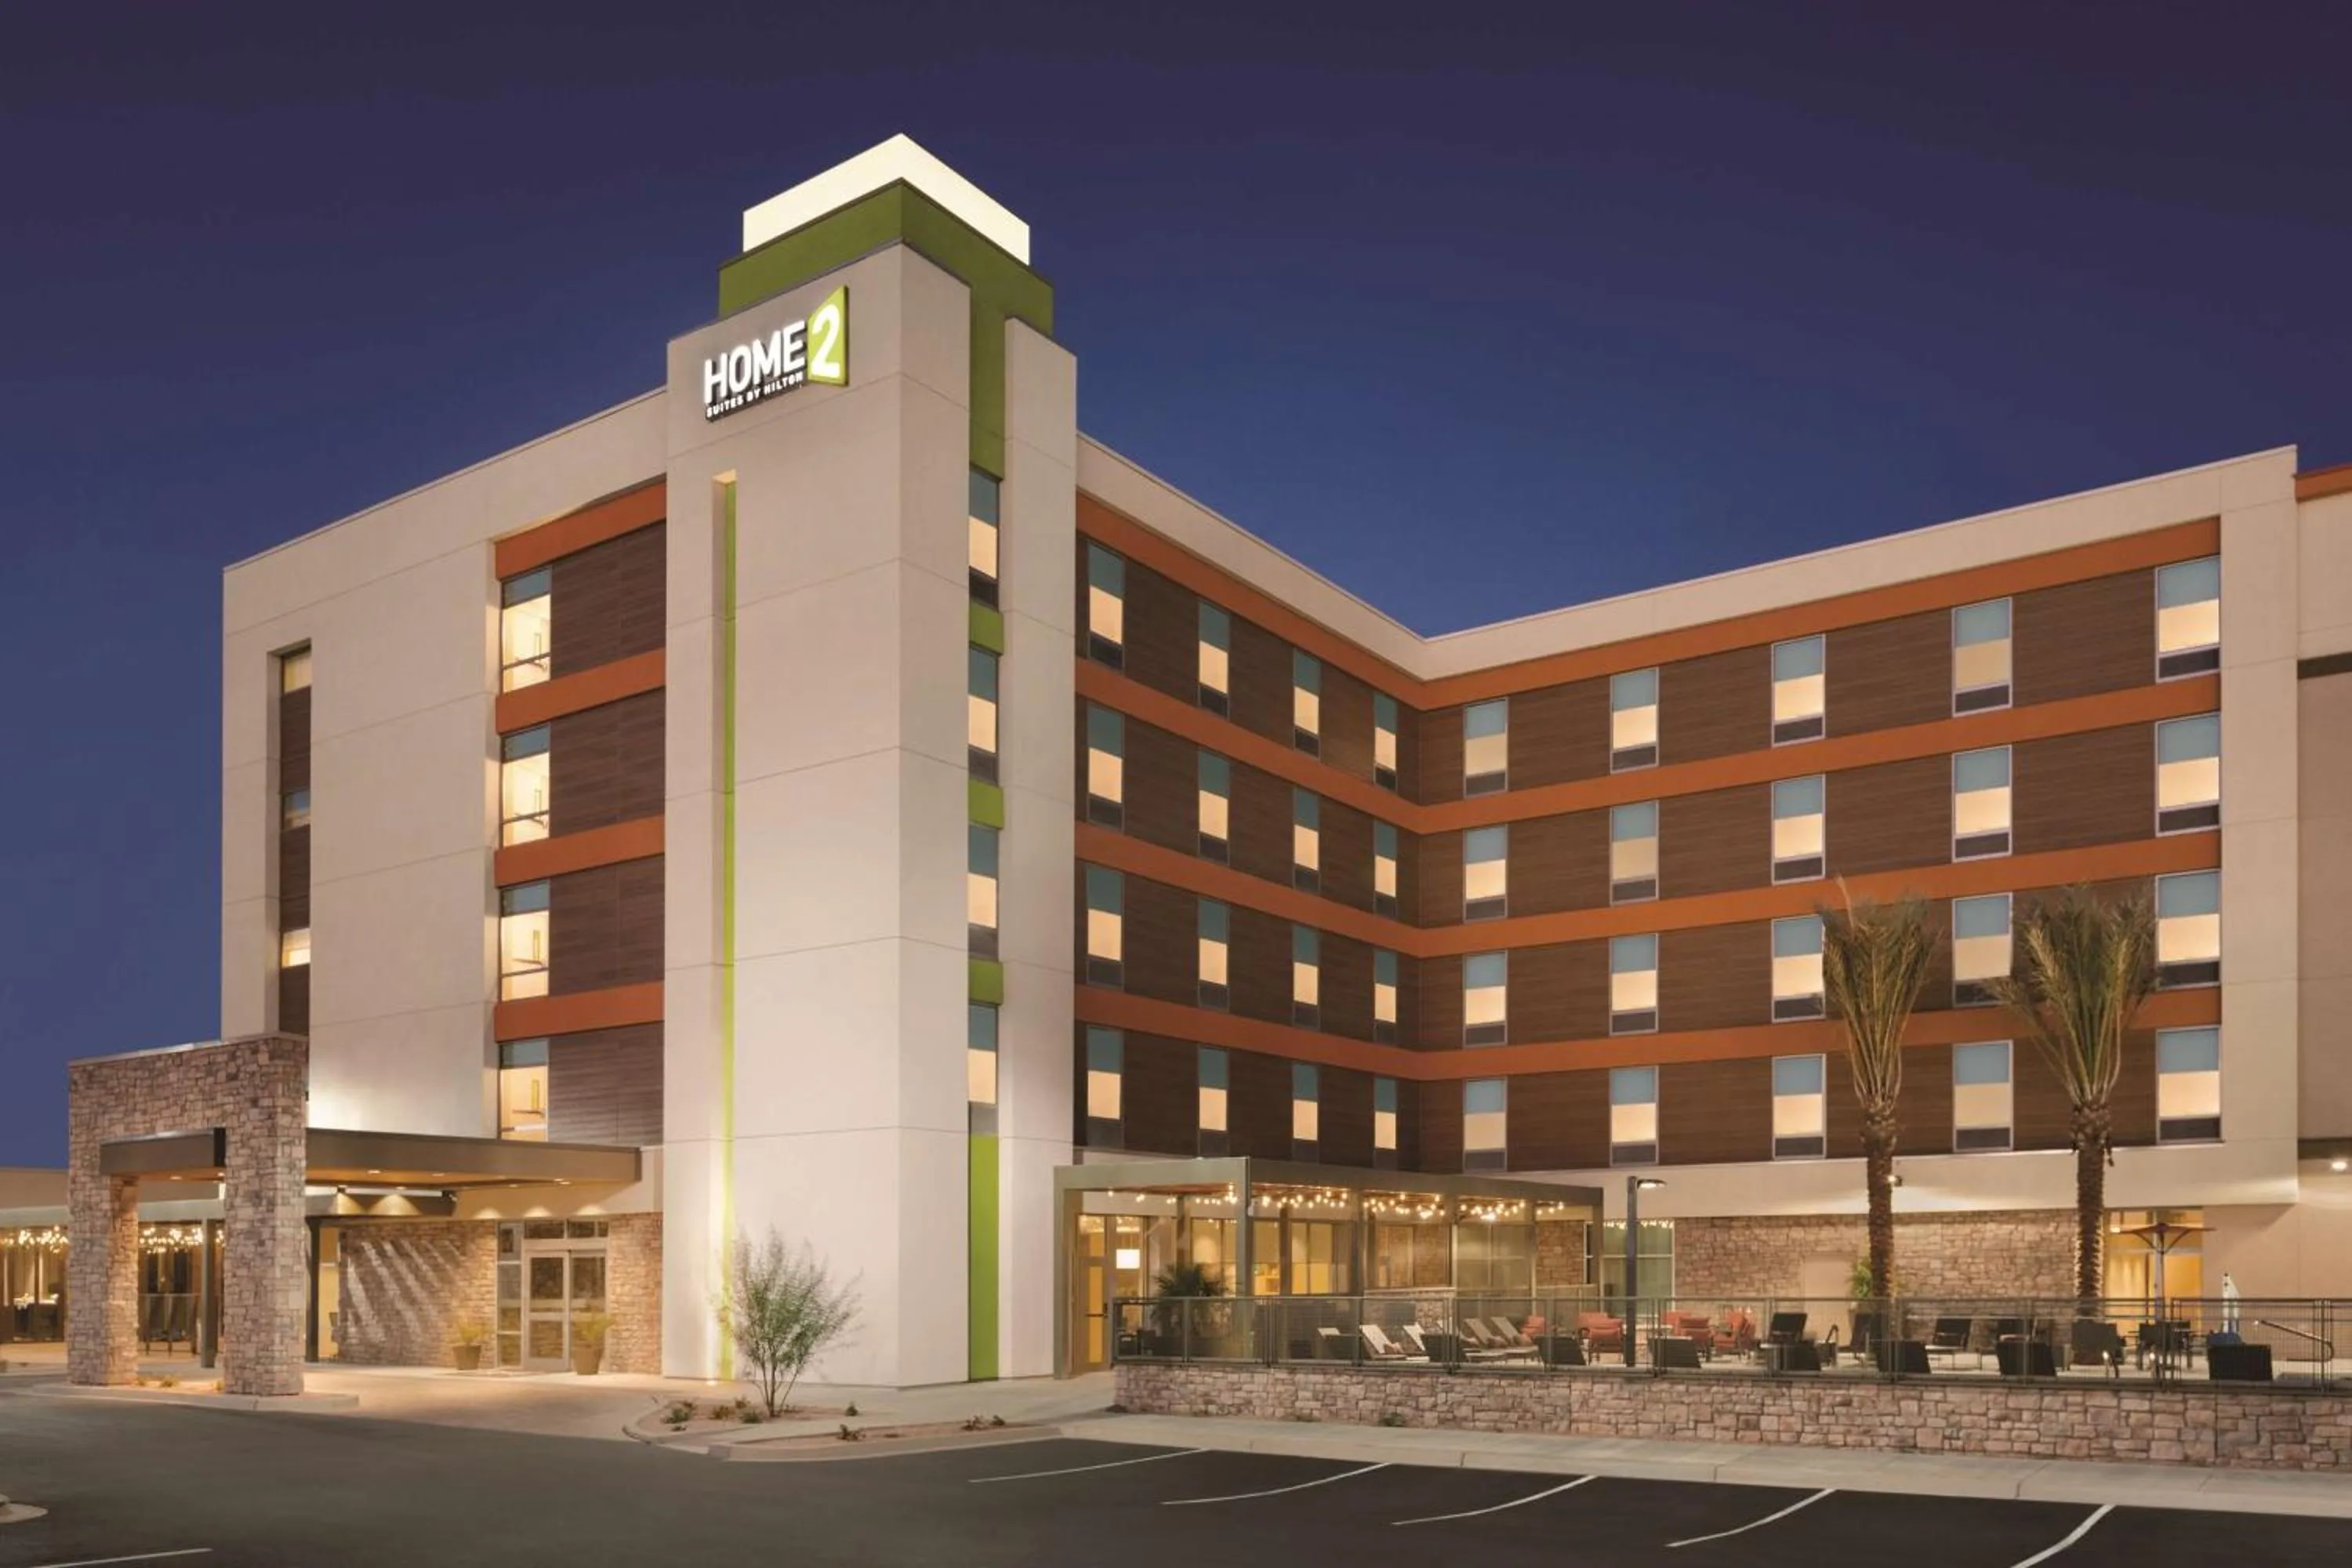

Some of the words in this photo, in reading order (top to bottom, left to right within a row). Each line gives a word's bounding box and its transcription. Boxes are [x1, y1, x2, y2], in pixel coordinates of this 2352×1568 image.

[706, 394, 744, 418] SUITES
[746, 388, 761, 402] BY
[764, 371, 803, 395] HILTON
